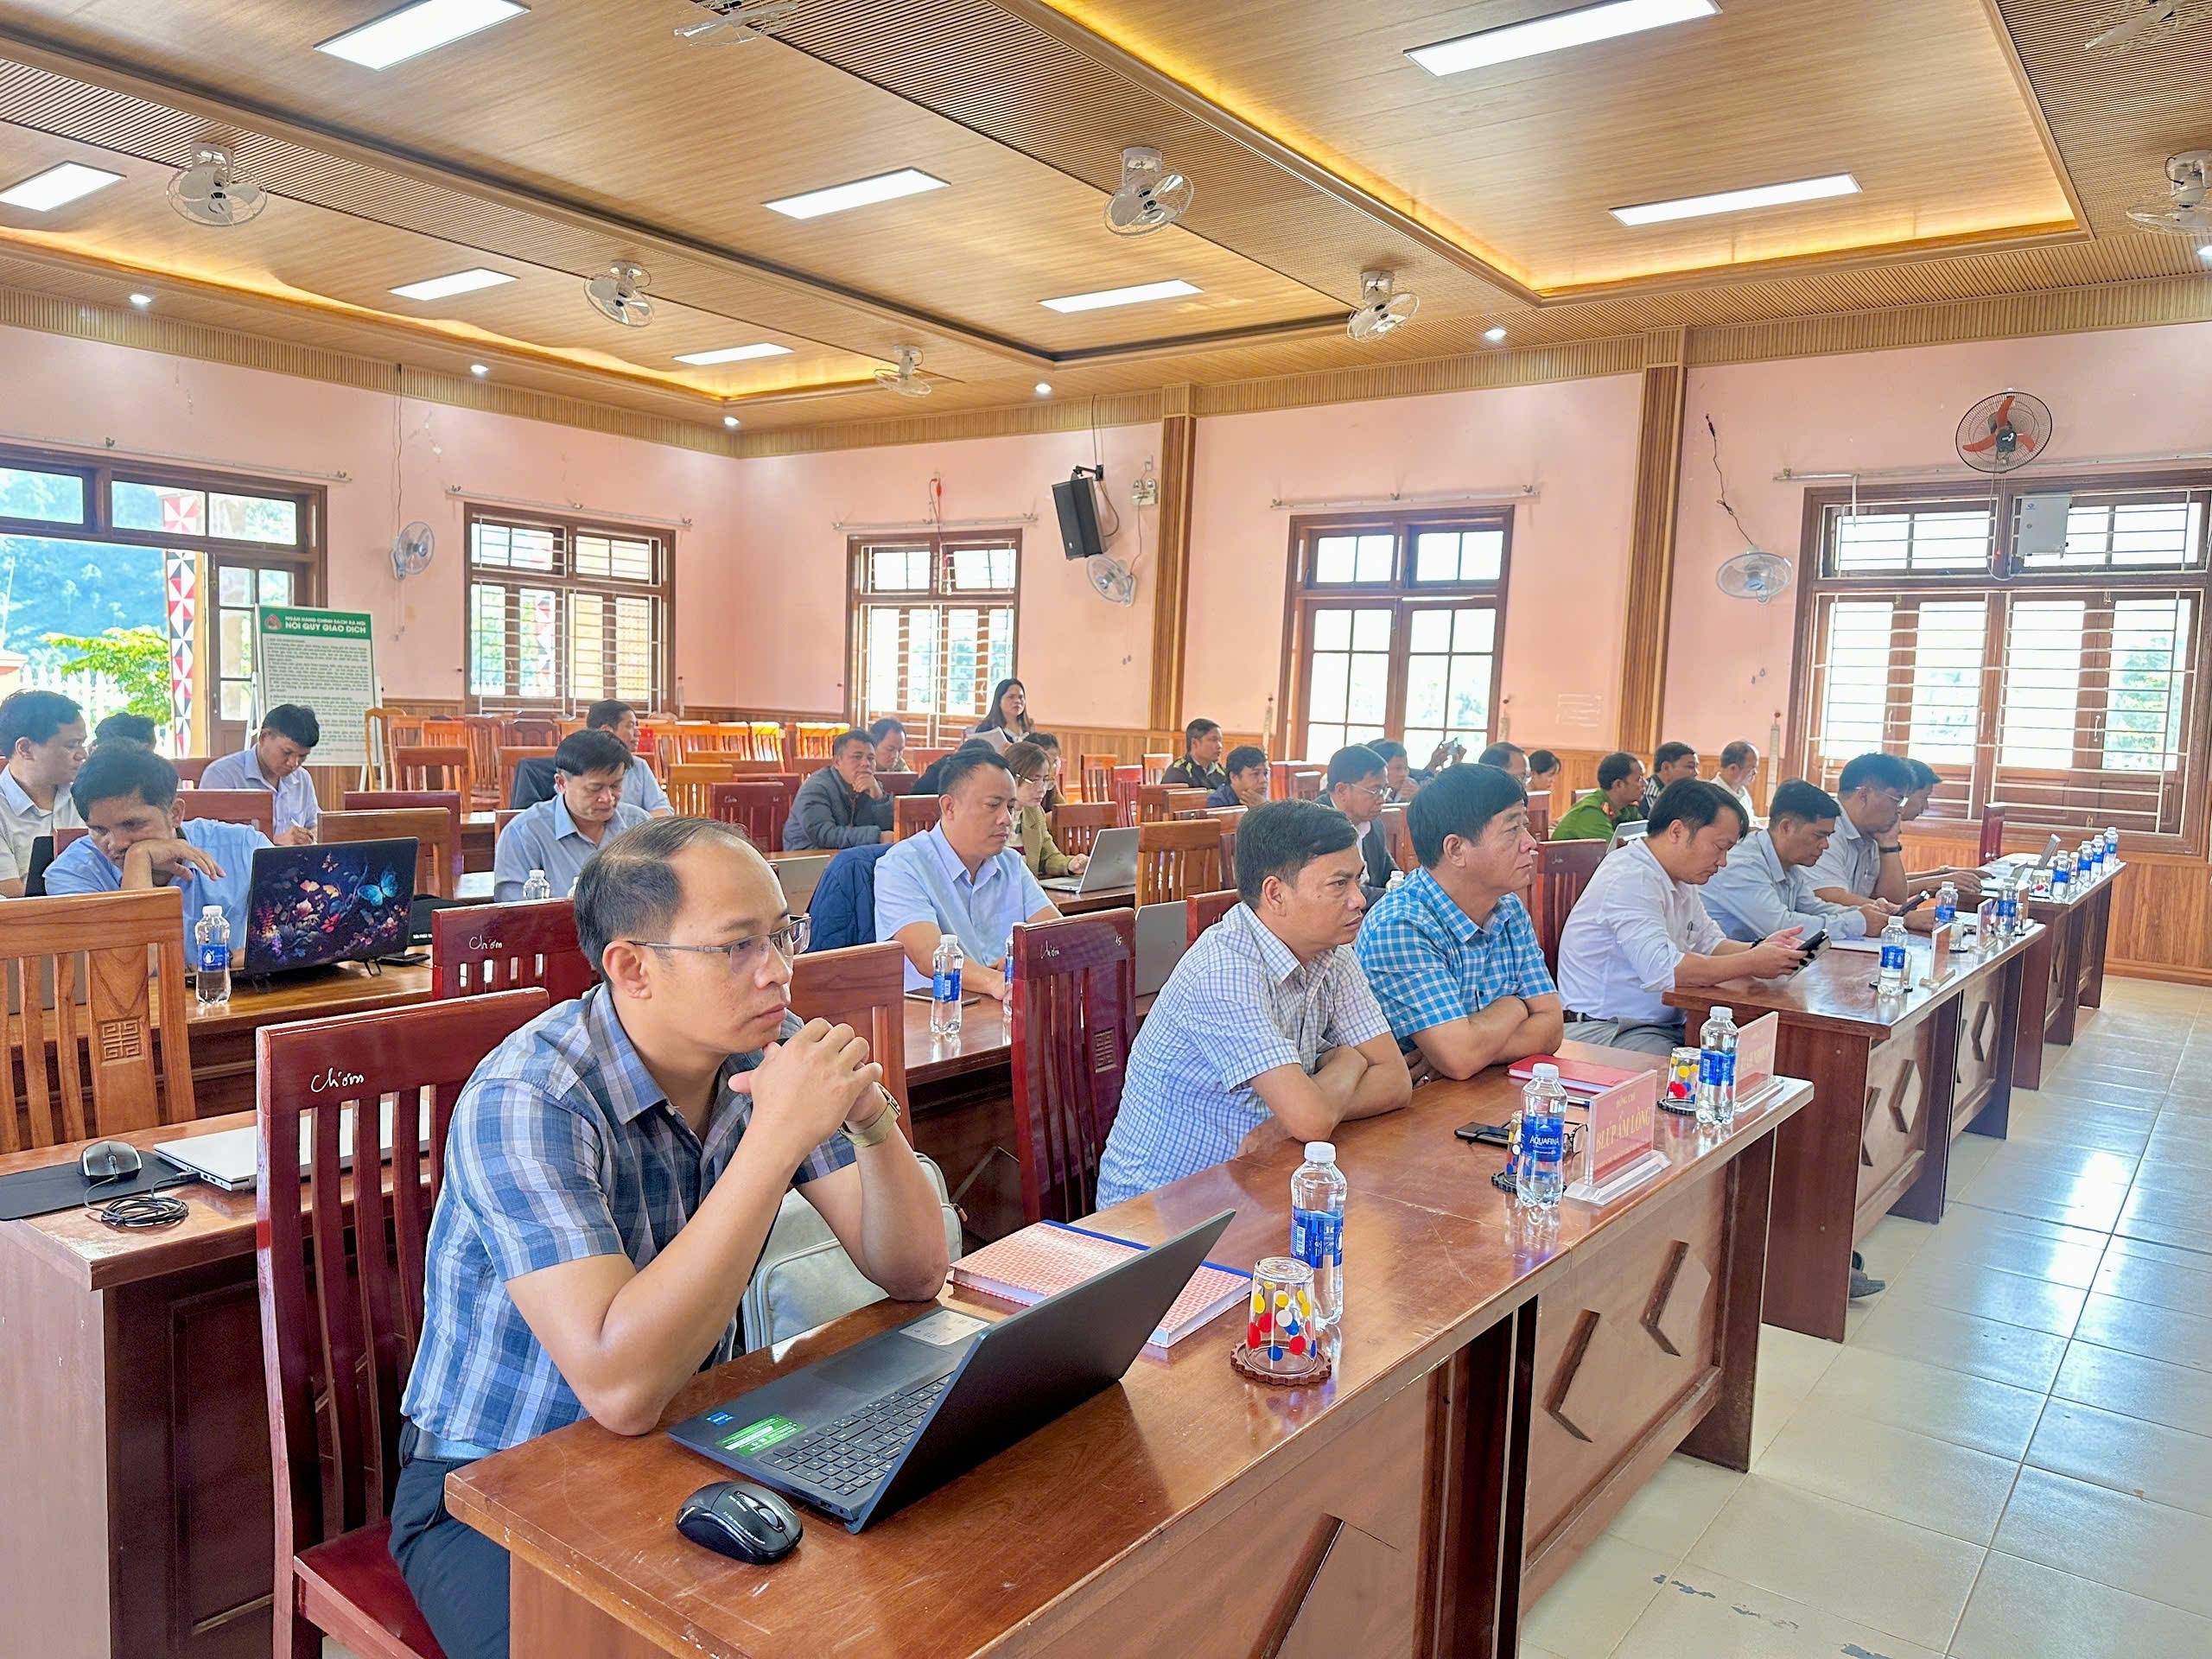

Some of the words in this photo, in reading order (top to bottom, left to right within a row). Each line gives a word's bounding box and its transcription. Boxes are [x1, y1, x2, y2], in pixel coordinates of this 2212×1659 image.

[302, 622, 321, 631] QUY
[322, 623, 345, 632] GIAO
[1529, 1135, 1560, 1146] AQUAFINA
